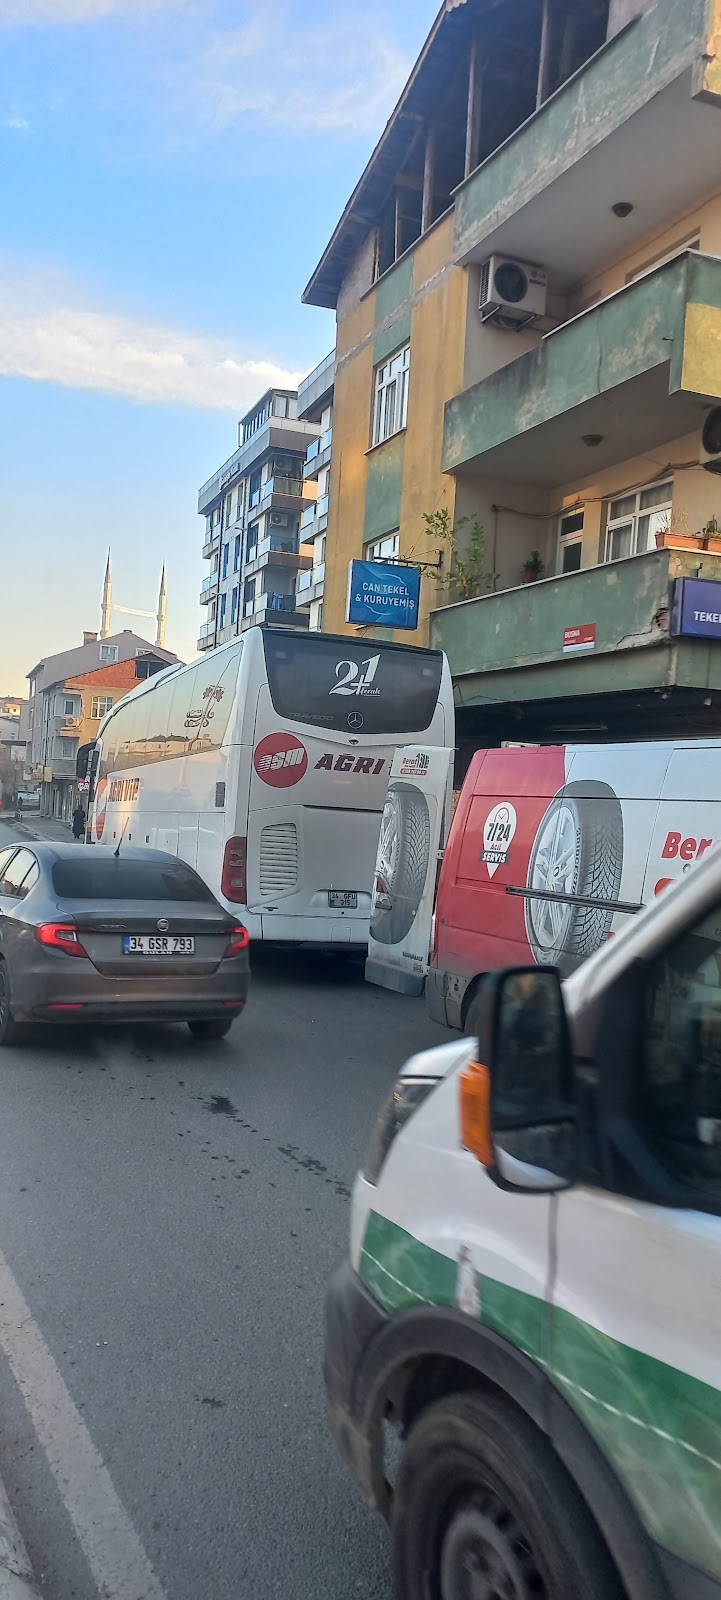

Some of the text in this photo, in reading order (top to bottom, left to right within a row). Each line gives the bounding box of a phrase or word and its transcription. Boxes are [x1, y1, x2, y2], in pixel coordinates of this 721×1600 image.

[362, 582, 410, 596] CAN TEKEL
[355, 593, 415, 610] & KURUYEMİŞ
[564, 629, 581, 639] BOSNA
[289, 712, 334, 722] TRAVEGO
[313, 751, 386, 775] AĞRI
[486, 822, 512, 842] 7/24
[661, 831, 713, 861] Ber
[130, 937, 193, 950] 34 GSR 793
